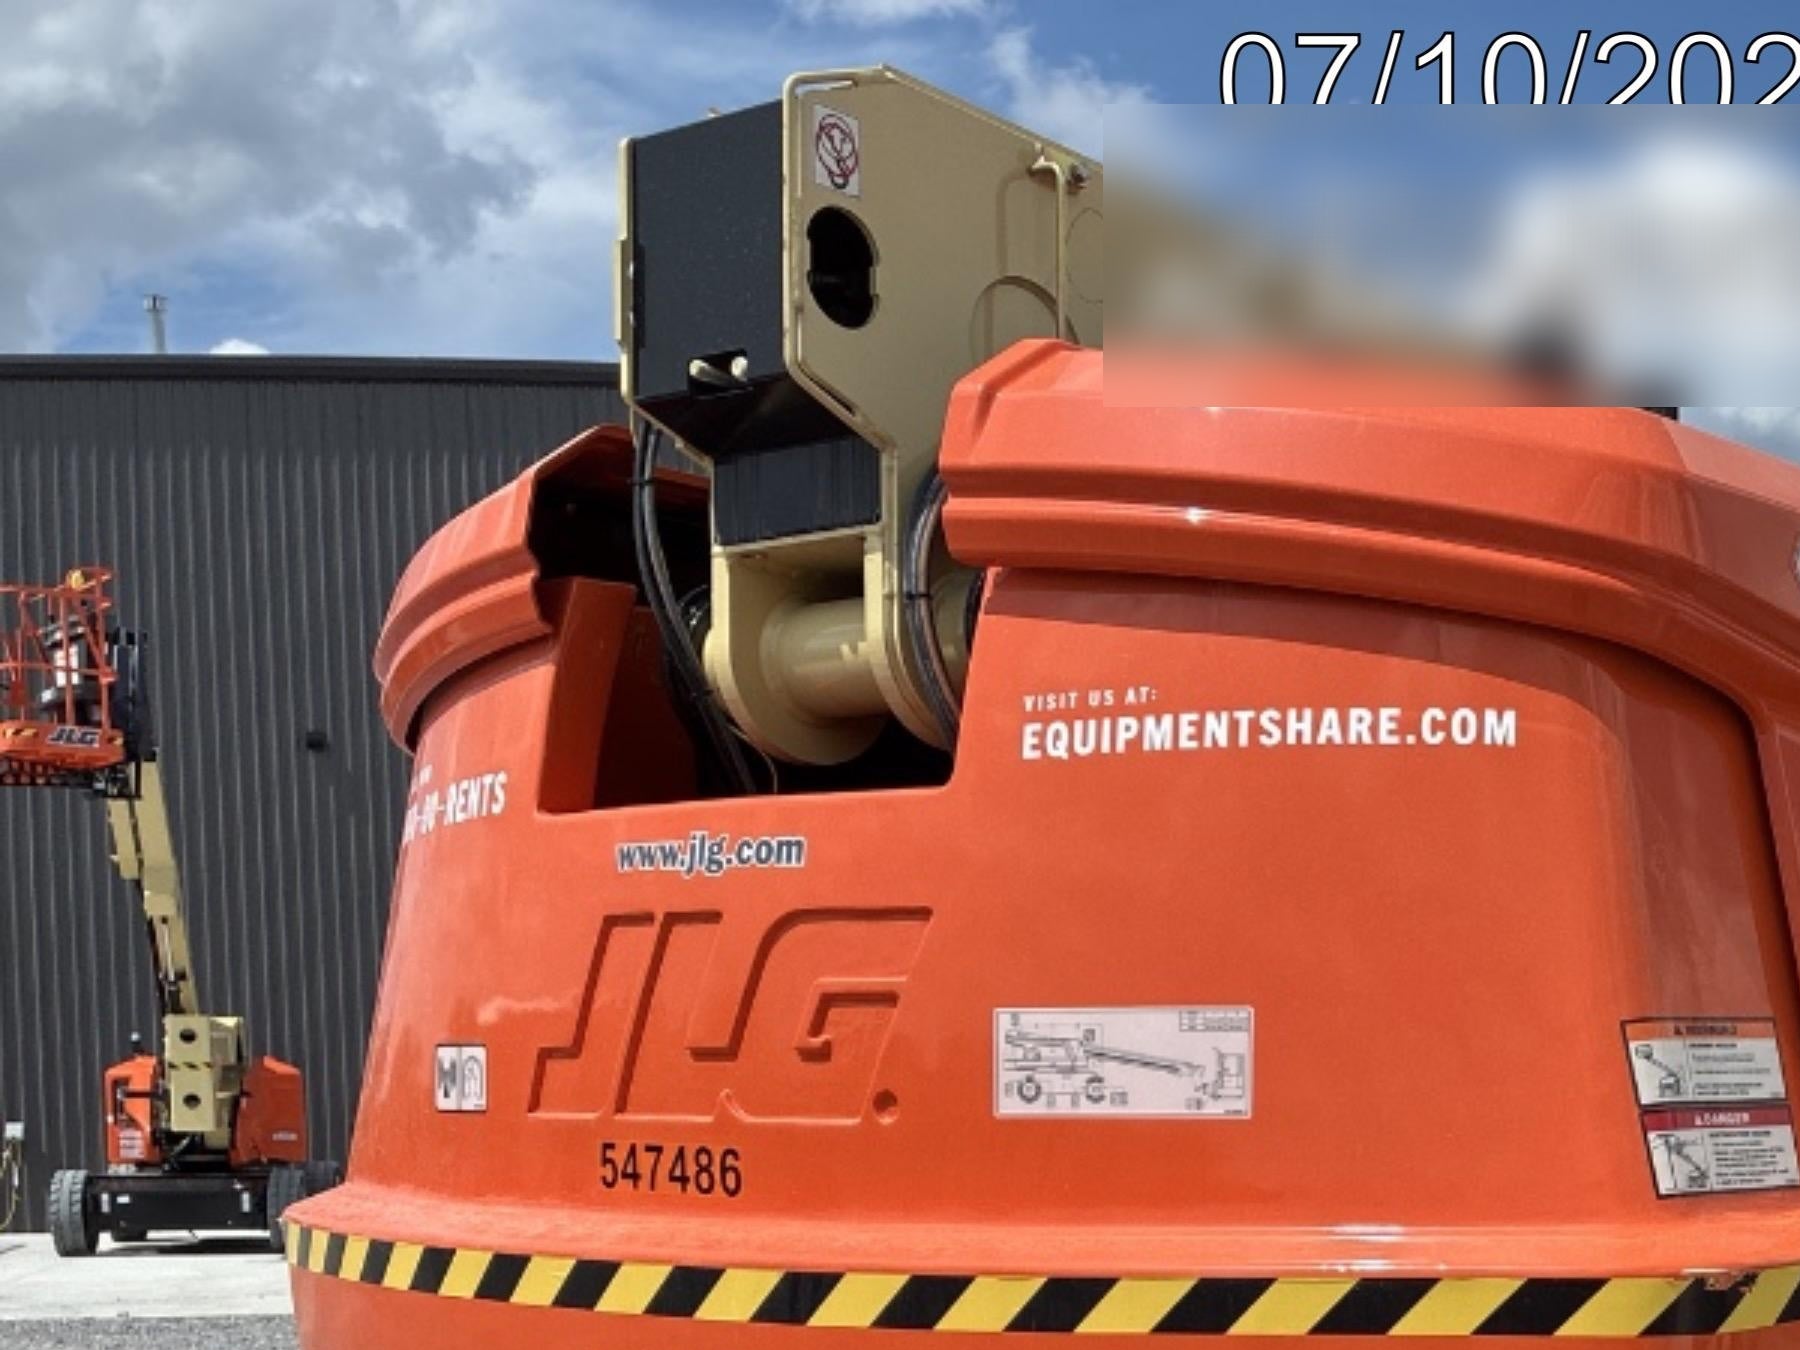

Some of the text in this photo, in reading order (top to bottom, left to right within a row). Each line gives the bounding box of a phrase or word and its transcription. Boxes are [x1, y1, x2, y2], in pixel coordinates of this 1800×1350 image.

[1022, 686, 1158, 713] VISIT US AT:
[47, 726, 102, 748] JLG
[1021, 707, 1518, 760] EQUIPMENTSHARE.COM
[616, 831, 806, 878] www.jlg.com
[600, 1142, 743, 1198] 547486
